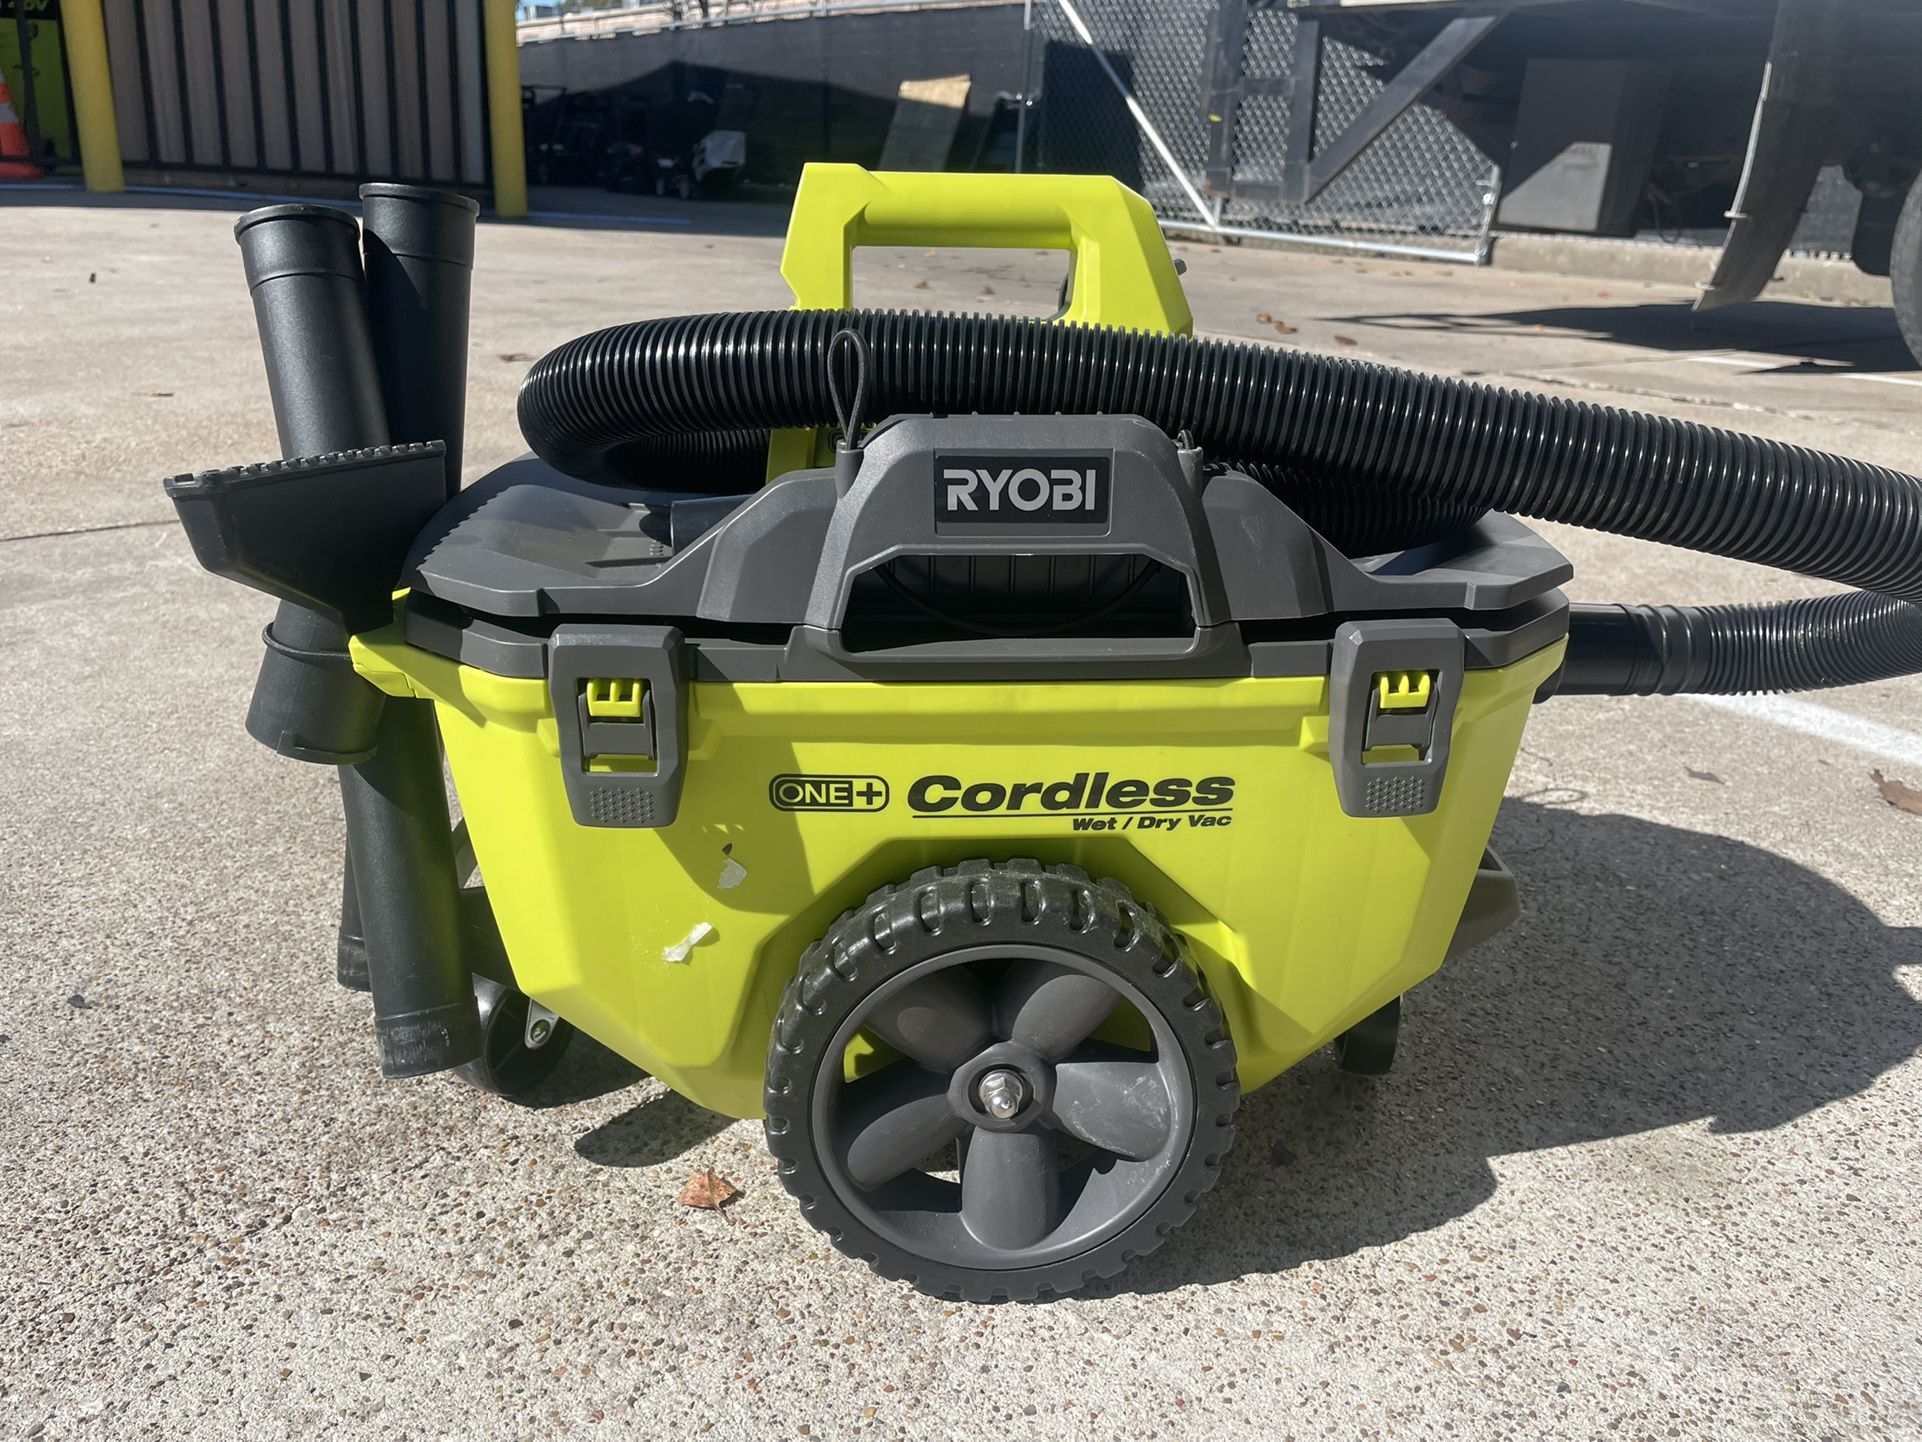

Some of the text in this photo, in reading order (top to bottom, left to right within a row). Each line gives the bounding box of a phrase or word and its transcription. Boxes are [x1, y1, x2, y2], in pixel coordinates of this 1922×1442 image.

[943, 468, 1096, 511] RYOBI
[907, 772, 1236, 812] Cordless
[1073, 817, 1117, 831] Wet
[1137, 816, 1182, 831] Dry
[1188, 814, 1232, 827] Vac
